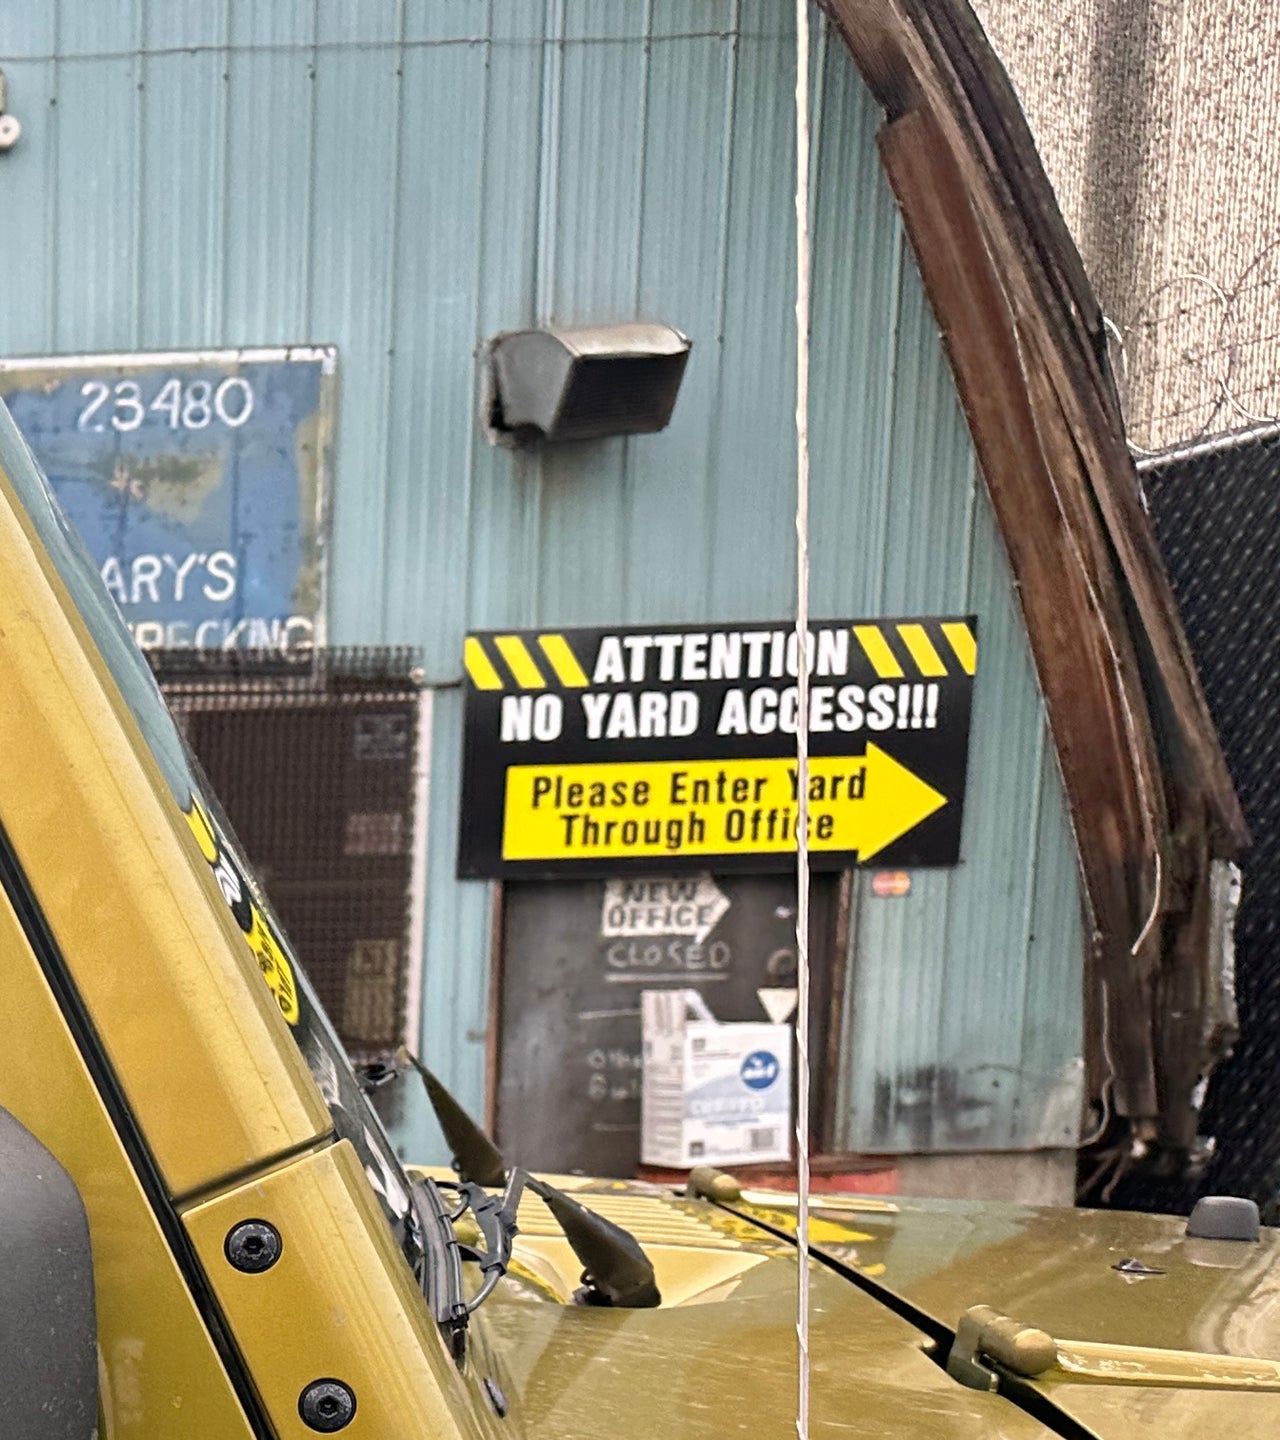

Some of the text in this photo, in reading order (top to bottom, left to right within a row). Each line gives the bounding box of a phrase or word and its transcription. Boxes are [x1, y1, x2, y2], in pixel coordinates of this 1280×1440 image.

[78, 376, 254, 432] 23480
[128, 616, 313, 664] RECKING
[593, 627, 849, 684] ATTENTION
[500, 683, 940, 742] NO YARD ACCESS!!!
[531, 766, 867, 810] Please Enter Yard
[559, 810, 707, 850] Through
[622, 880, 697, 902] NEW
[608, 904, 712, 929] OFFICE
[607, 940, 731, 970] CLOSED
